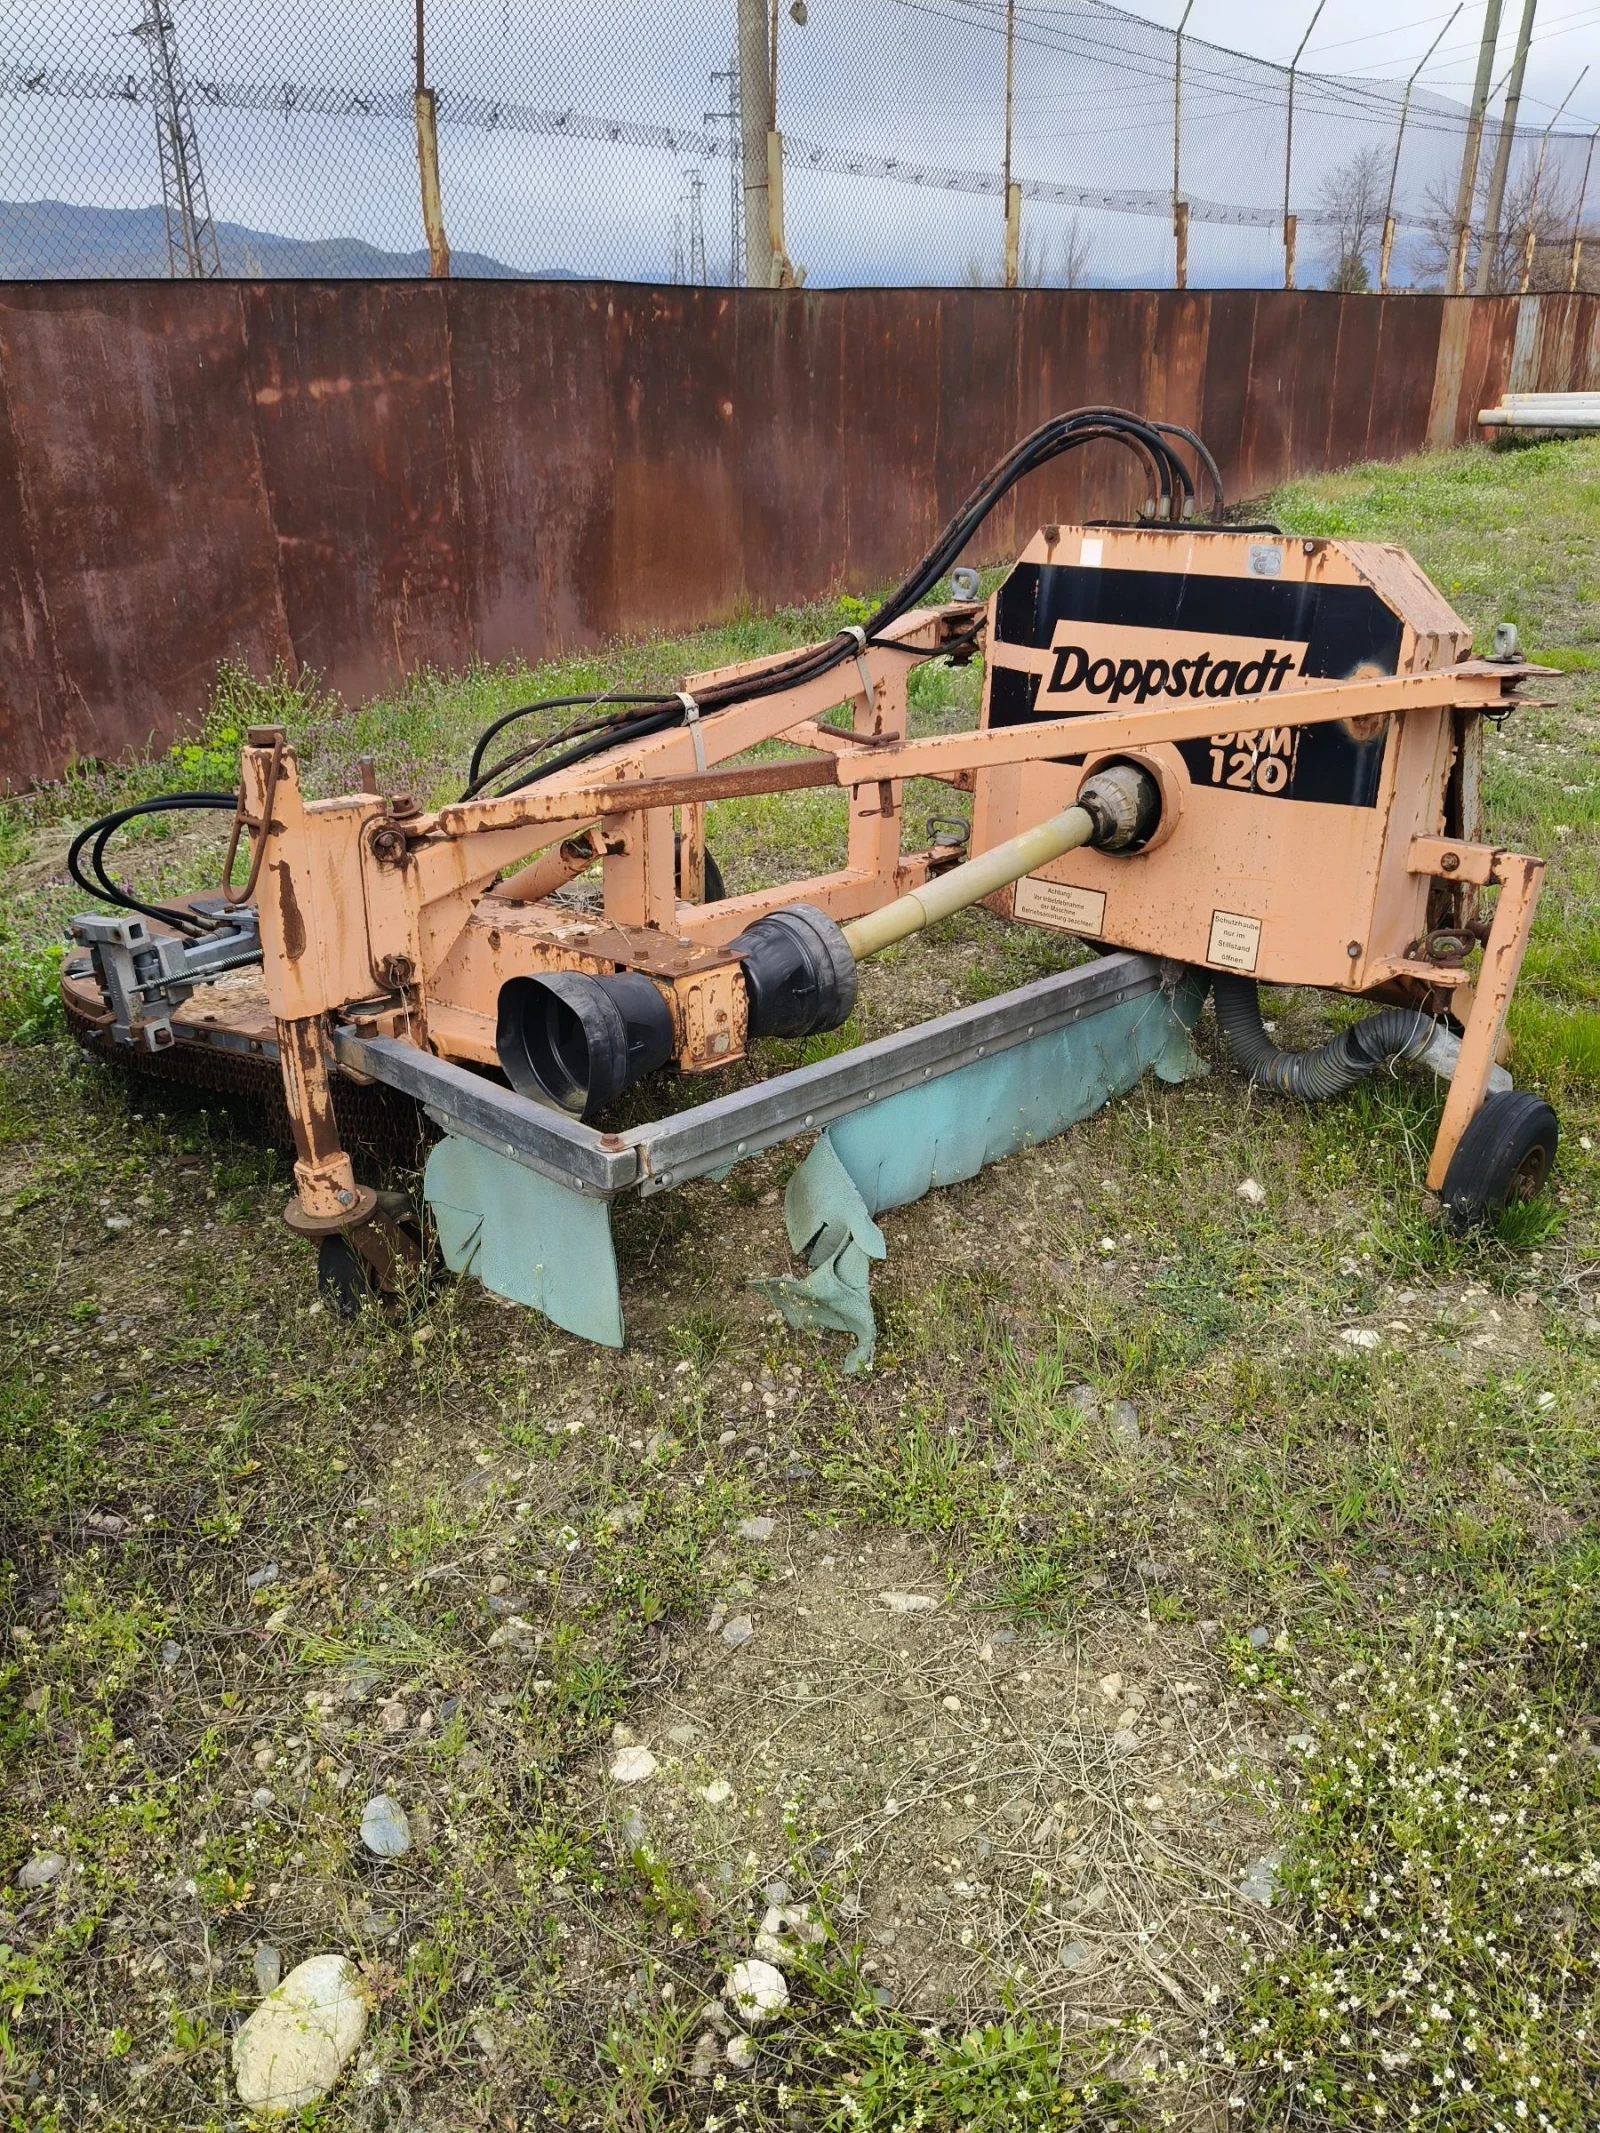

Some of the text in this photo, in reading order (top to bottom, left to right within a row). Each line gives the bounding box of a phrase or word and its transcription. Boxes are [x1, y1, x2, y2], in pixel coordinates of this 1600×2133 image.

[1047, 646, 1295, 704] Doppstadt
[1209, 748, 1288, 793] 120
[1214, 915, 1260, 931] Schutzhaube
[1236, 932, 1246, 940] im
[1217, 940, 1251, 952] Stillstand
[1221, 954, 1244, 964] öffnen
